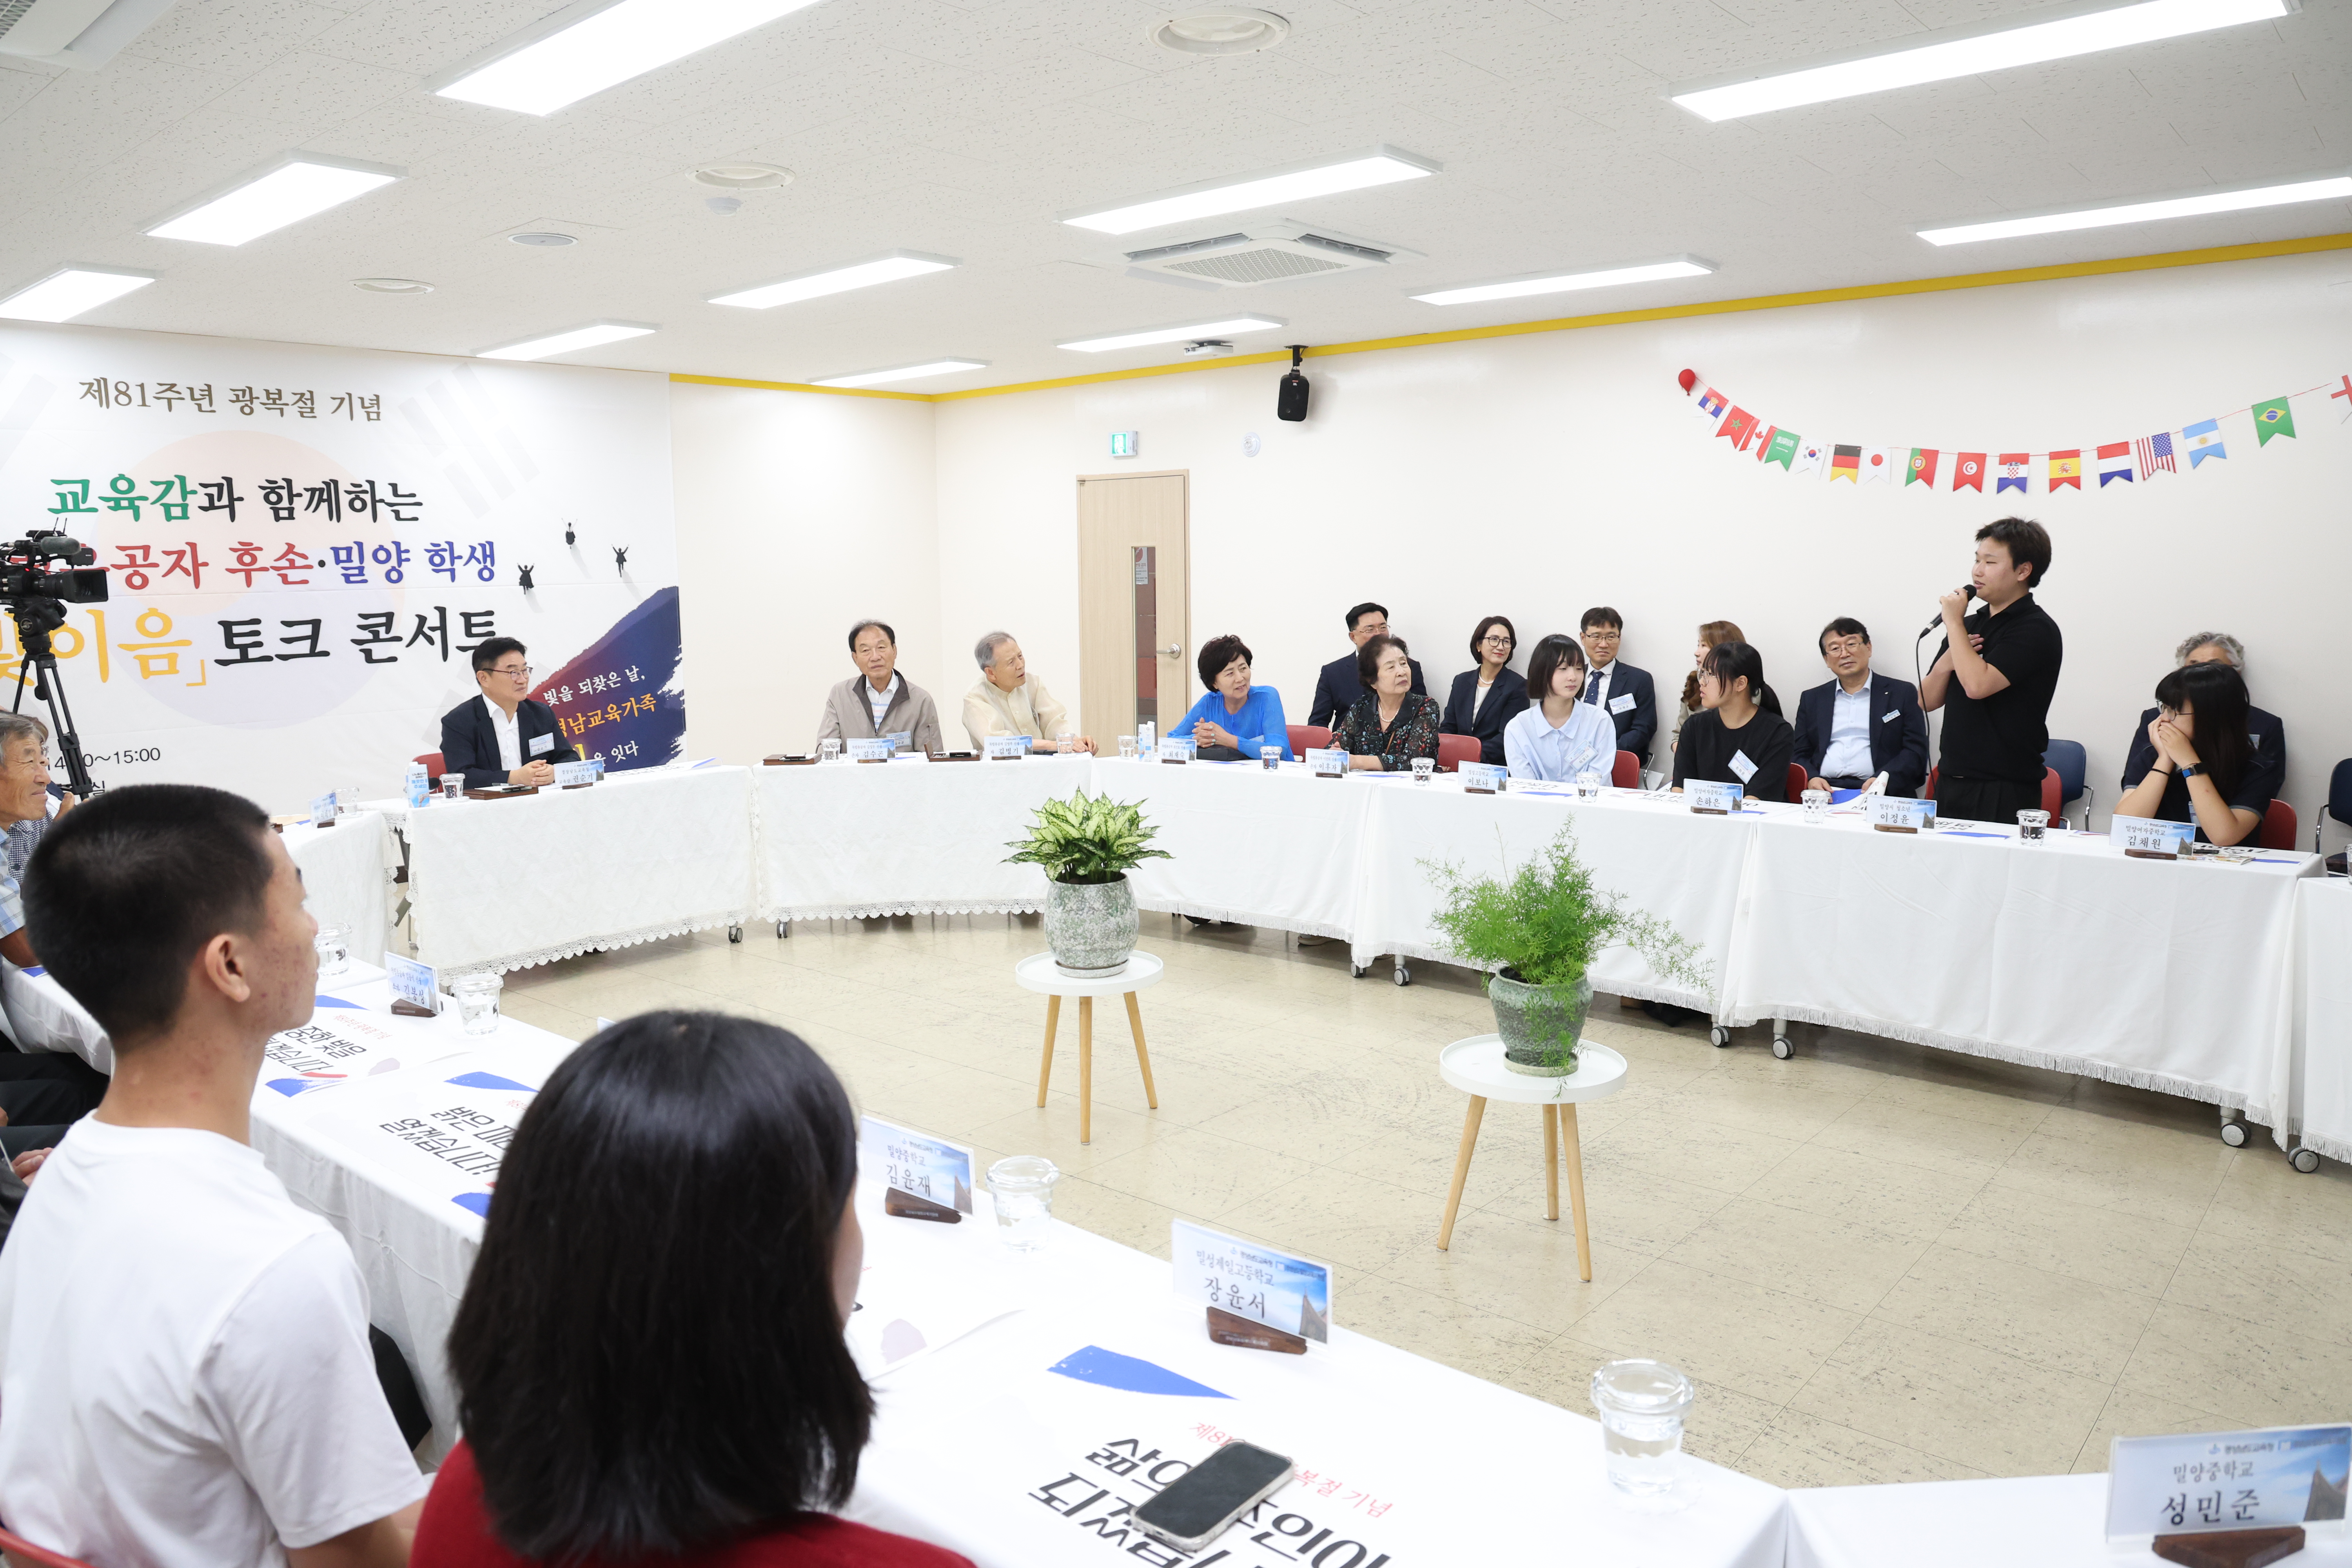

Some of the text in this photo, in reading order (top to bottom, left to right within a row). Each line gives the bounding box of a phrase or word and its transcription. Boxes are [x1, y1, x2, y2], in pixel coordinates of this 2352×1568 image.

[78, 377, 382, 421] 제81주년 광복절 기념
[47, 474, 423, 523] 교육감과 함께하는
[225, 541, 411, 588] 후손·밀양
[424, 541, 495, 583] 학생
[214, 618, 330, 666] 토크
[350, 606, 496, 664] 콘서트
[543, 666, 645, 707] 빛을 되찾은 날,
[611, 740, 639, 763] 잇다
[1169, 751, 1185, 759] 최재숙
[573, 773, 593, 783] 권순기
[1319, 762, 1337, 772] 이후자
[1468, 777, 1488, 788] 이보나
[1696, 797, 1720, 807] 손하은
[1880, 812, 1909, 824] 이정윤
[2126, 825, 2165, 836] 밀양여자중학교
[2127, 835, 2160, 849] 김채원
[392, 983, 425, 1004] 손자 김봉성
[281, 1026, 367, 1058] 중한 빛을
[430, 1107, 495, 1131] 밝은
[887, 1145, 926, 1167] 밀양중학교
[886, 1164, 930, 1198] 김윤재
[1196, 1250, 1274, 1287] 밀성제일고등학교
[1204, 1277, 1265, 1319] 장윤서
[2173, 1460, 2255, 1485] 밀양중학교
[1291, 1464, 1342, 1498] 복절
[1341, 1490, 1394, 1519] 기념
[2161, 1489, 2260, 1526] 성민준
